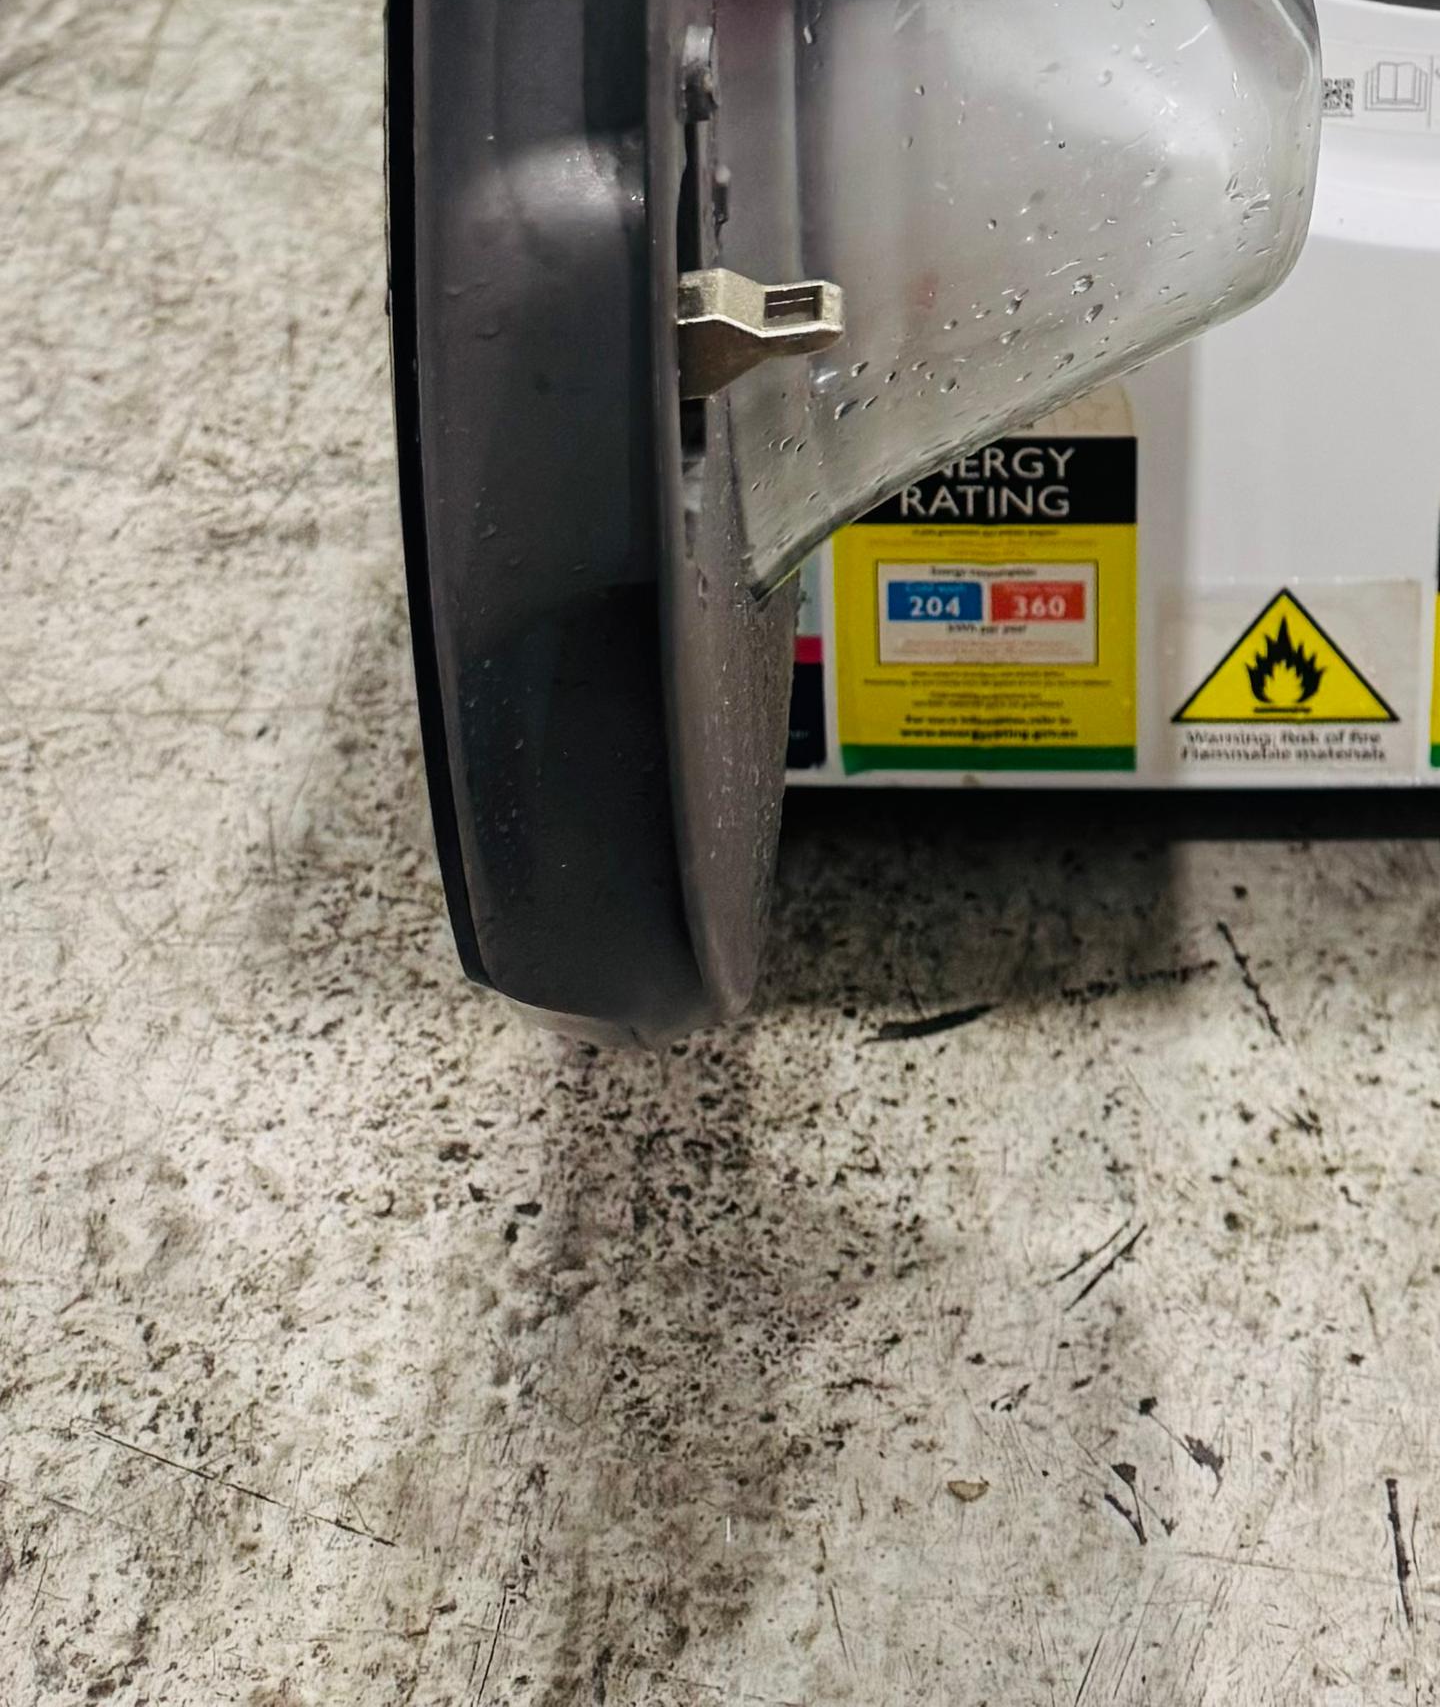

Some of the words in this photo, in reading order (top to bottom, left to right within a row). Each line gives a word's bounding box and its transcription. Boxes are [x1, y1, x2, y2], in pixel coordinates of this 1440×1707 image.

[938, 446, 1076, 480] ERGY
[901, 486, 1070, 518] RATING
[909, 595, 961, 618] 204
[1013, 595, 1067, 618] 360
